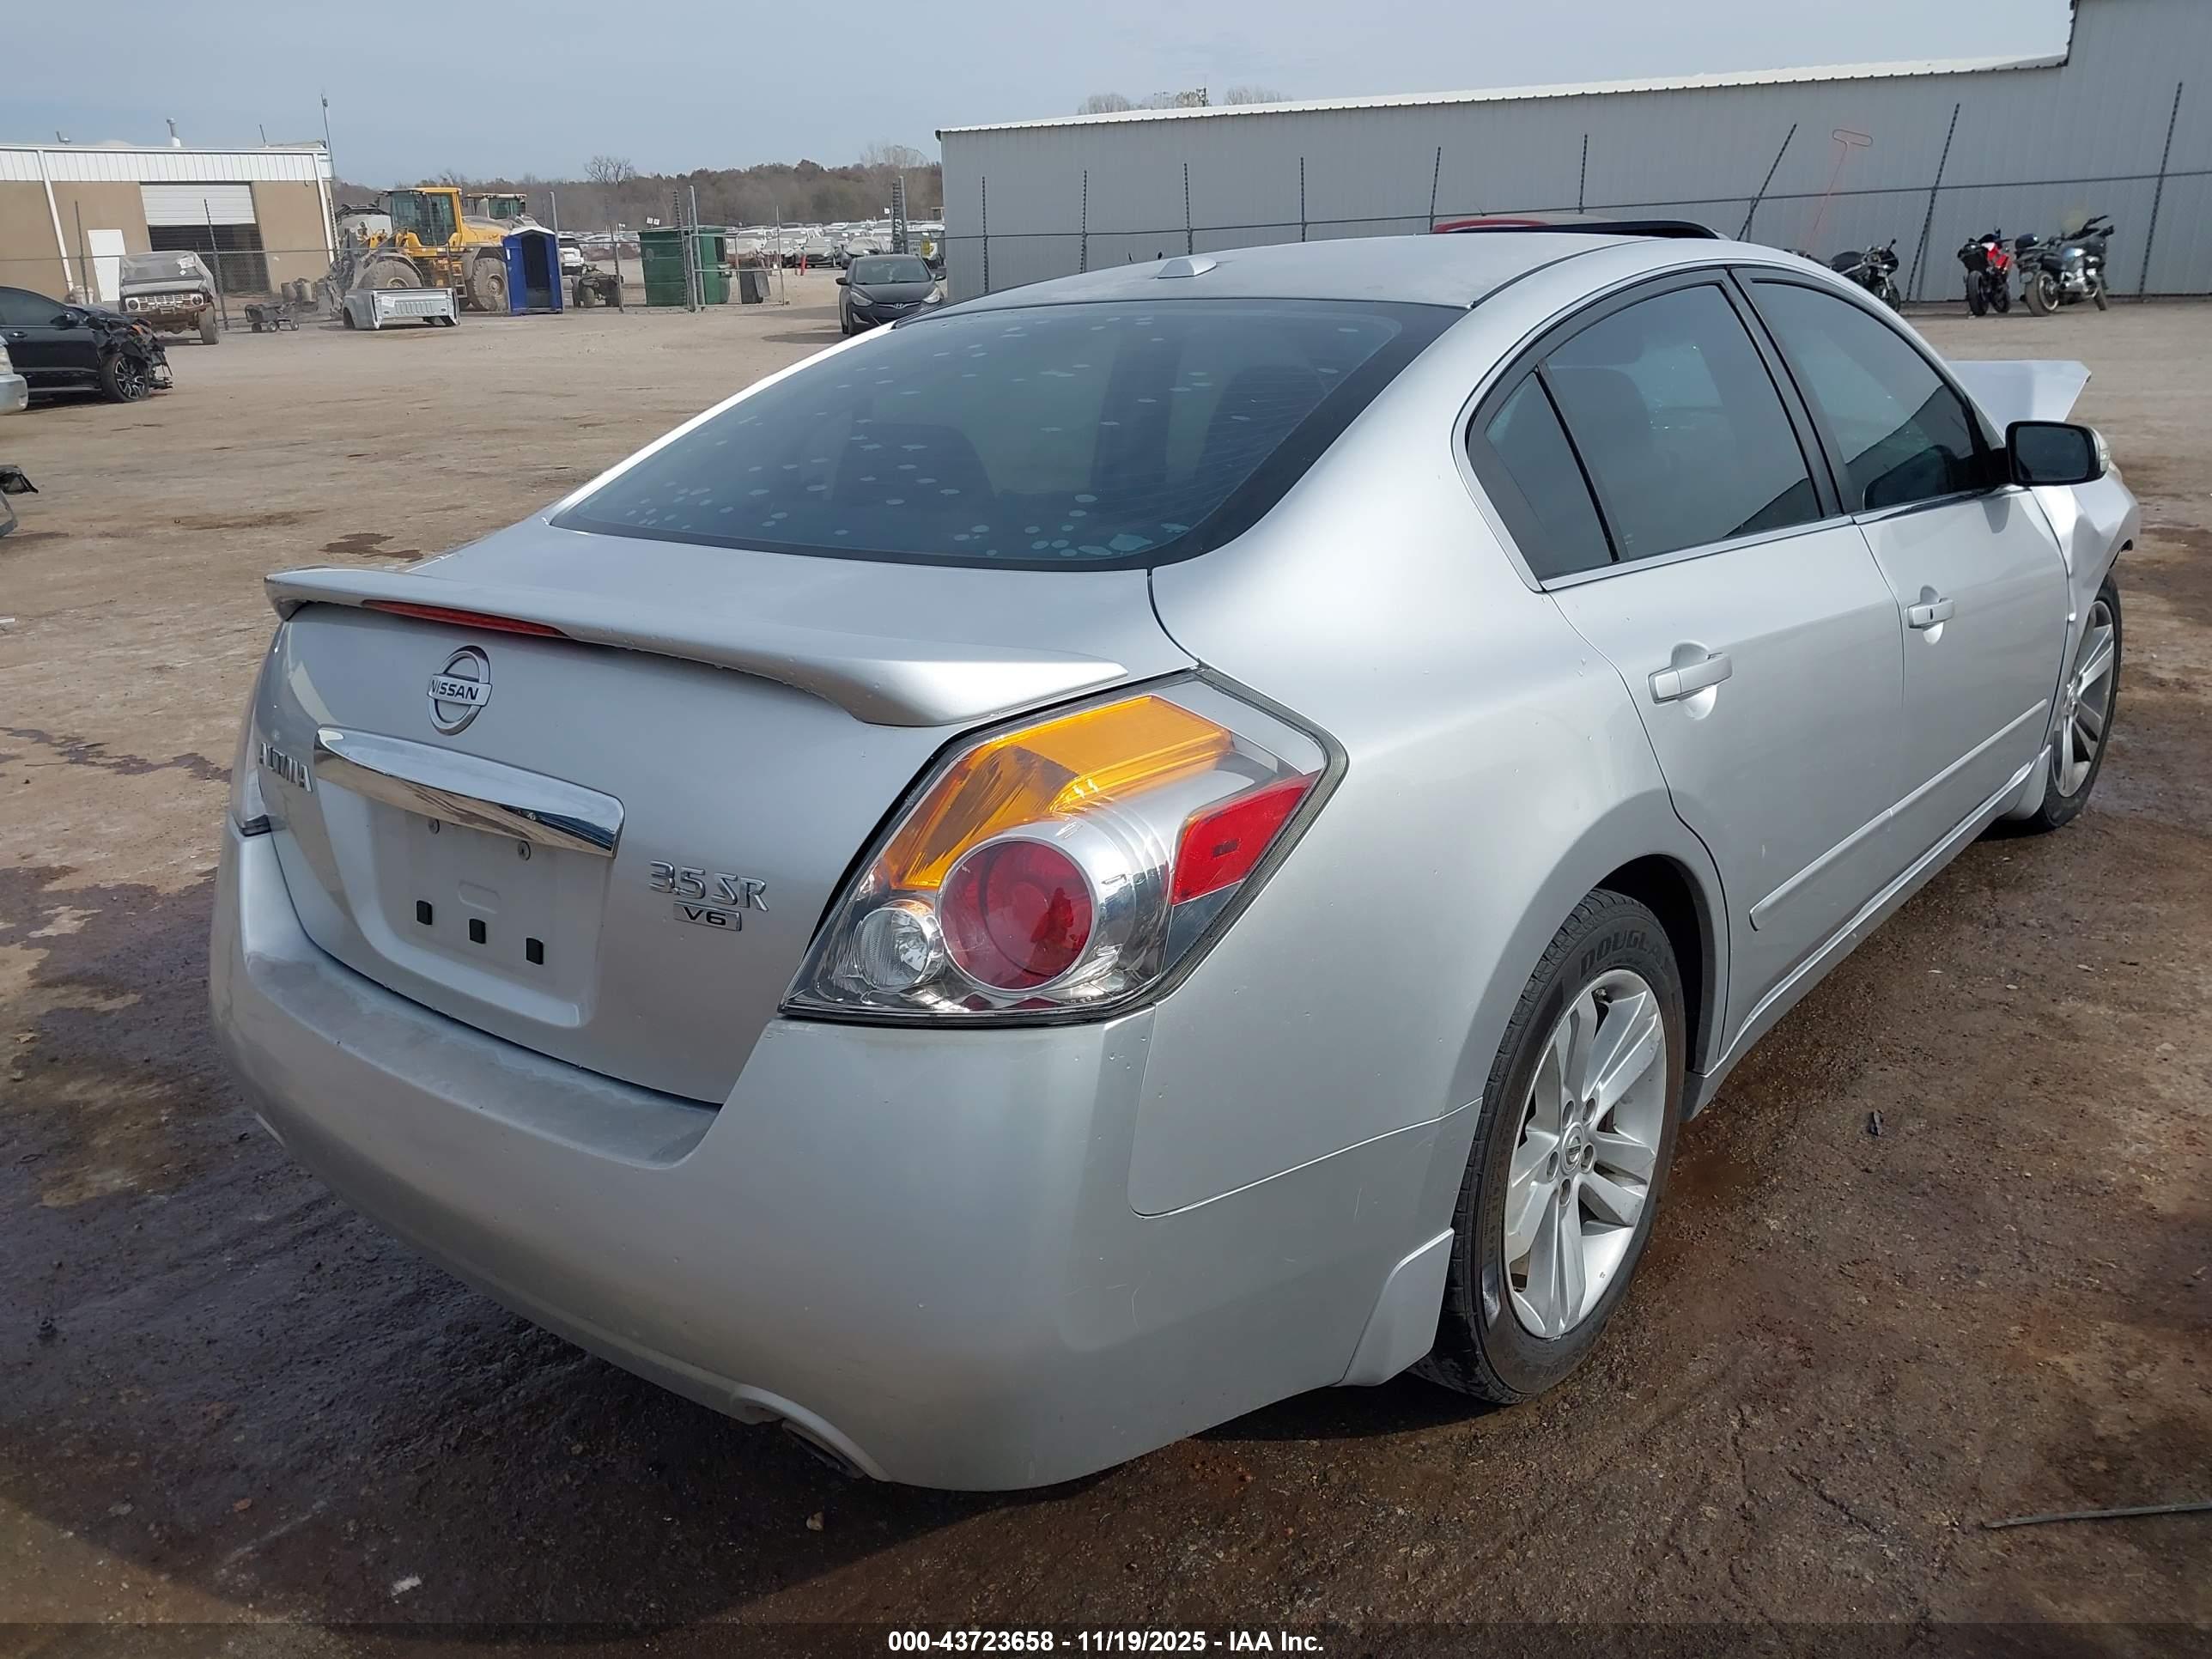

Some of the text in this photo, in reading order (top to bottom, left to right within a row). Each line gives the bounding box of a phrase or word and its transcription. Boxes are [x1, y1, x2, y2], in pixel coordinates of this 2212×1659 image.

[431, 679, 480, 701] NISSAN
[648, 860, 769, 912] 3.5 SR
[683, 906, 726, 927] V6
